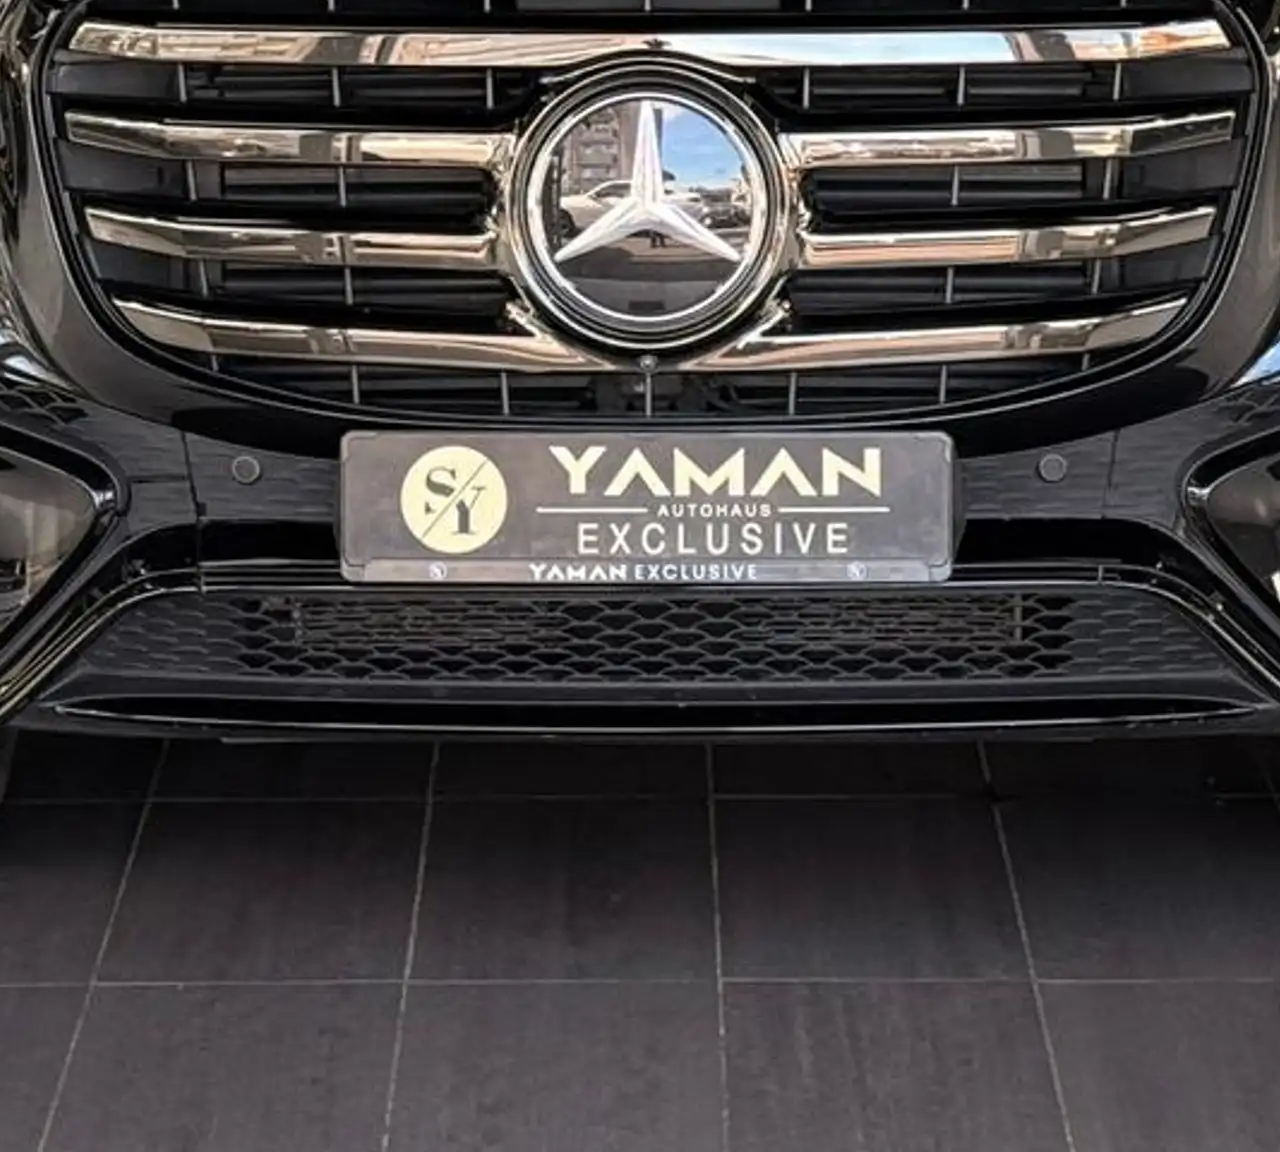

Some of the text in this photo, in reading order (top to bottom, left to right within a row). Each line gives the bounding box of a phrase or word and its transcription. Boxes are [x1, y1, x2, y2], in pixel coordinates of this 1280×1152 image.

[549, 446, 882, 496] YAMAN
[657, 503, 772, 517] AUTOHAUS
[578, 522, 849, 555] EXCLUSIVE
[529, 563, 757, 580] YAMAN EXCLUSIVE
